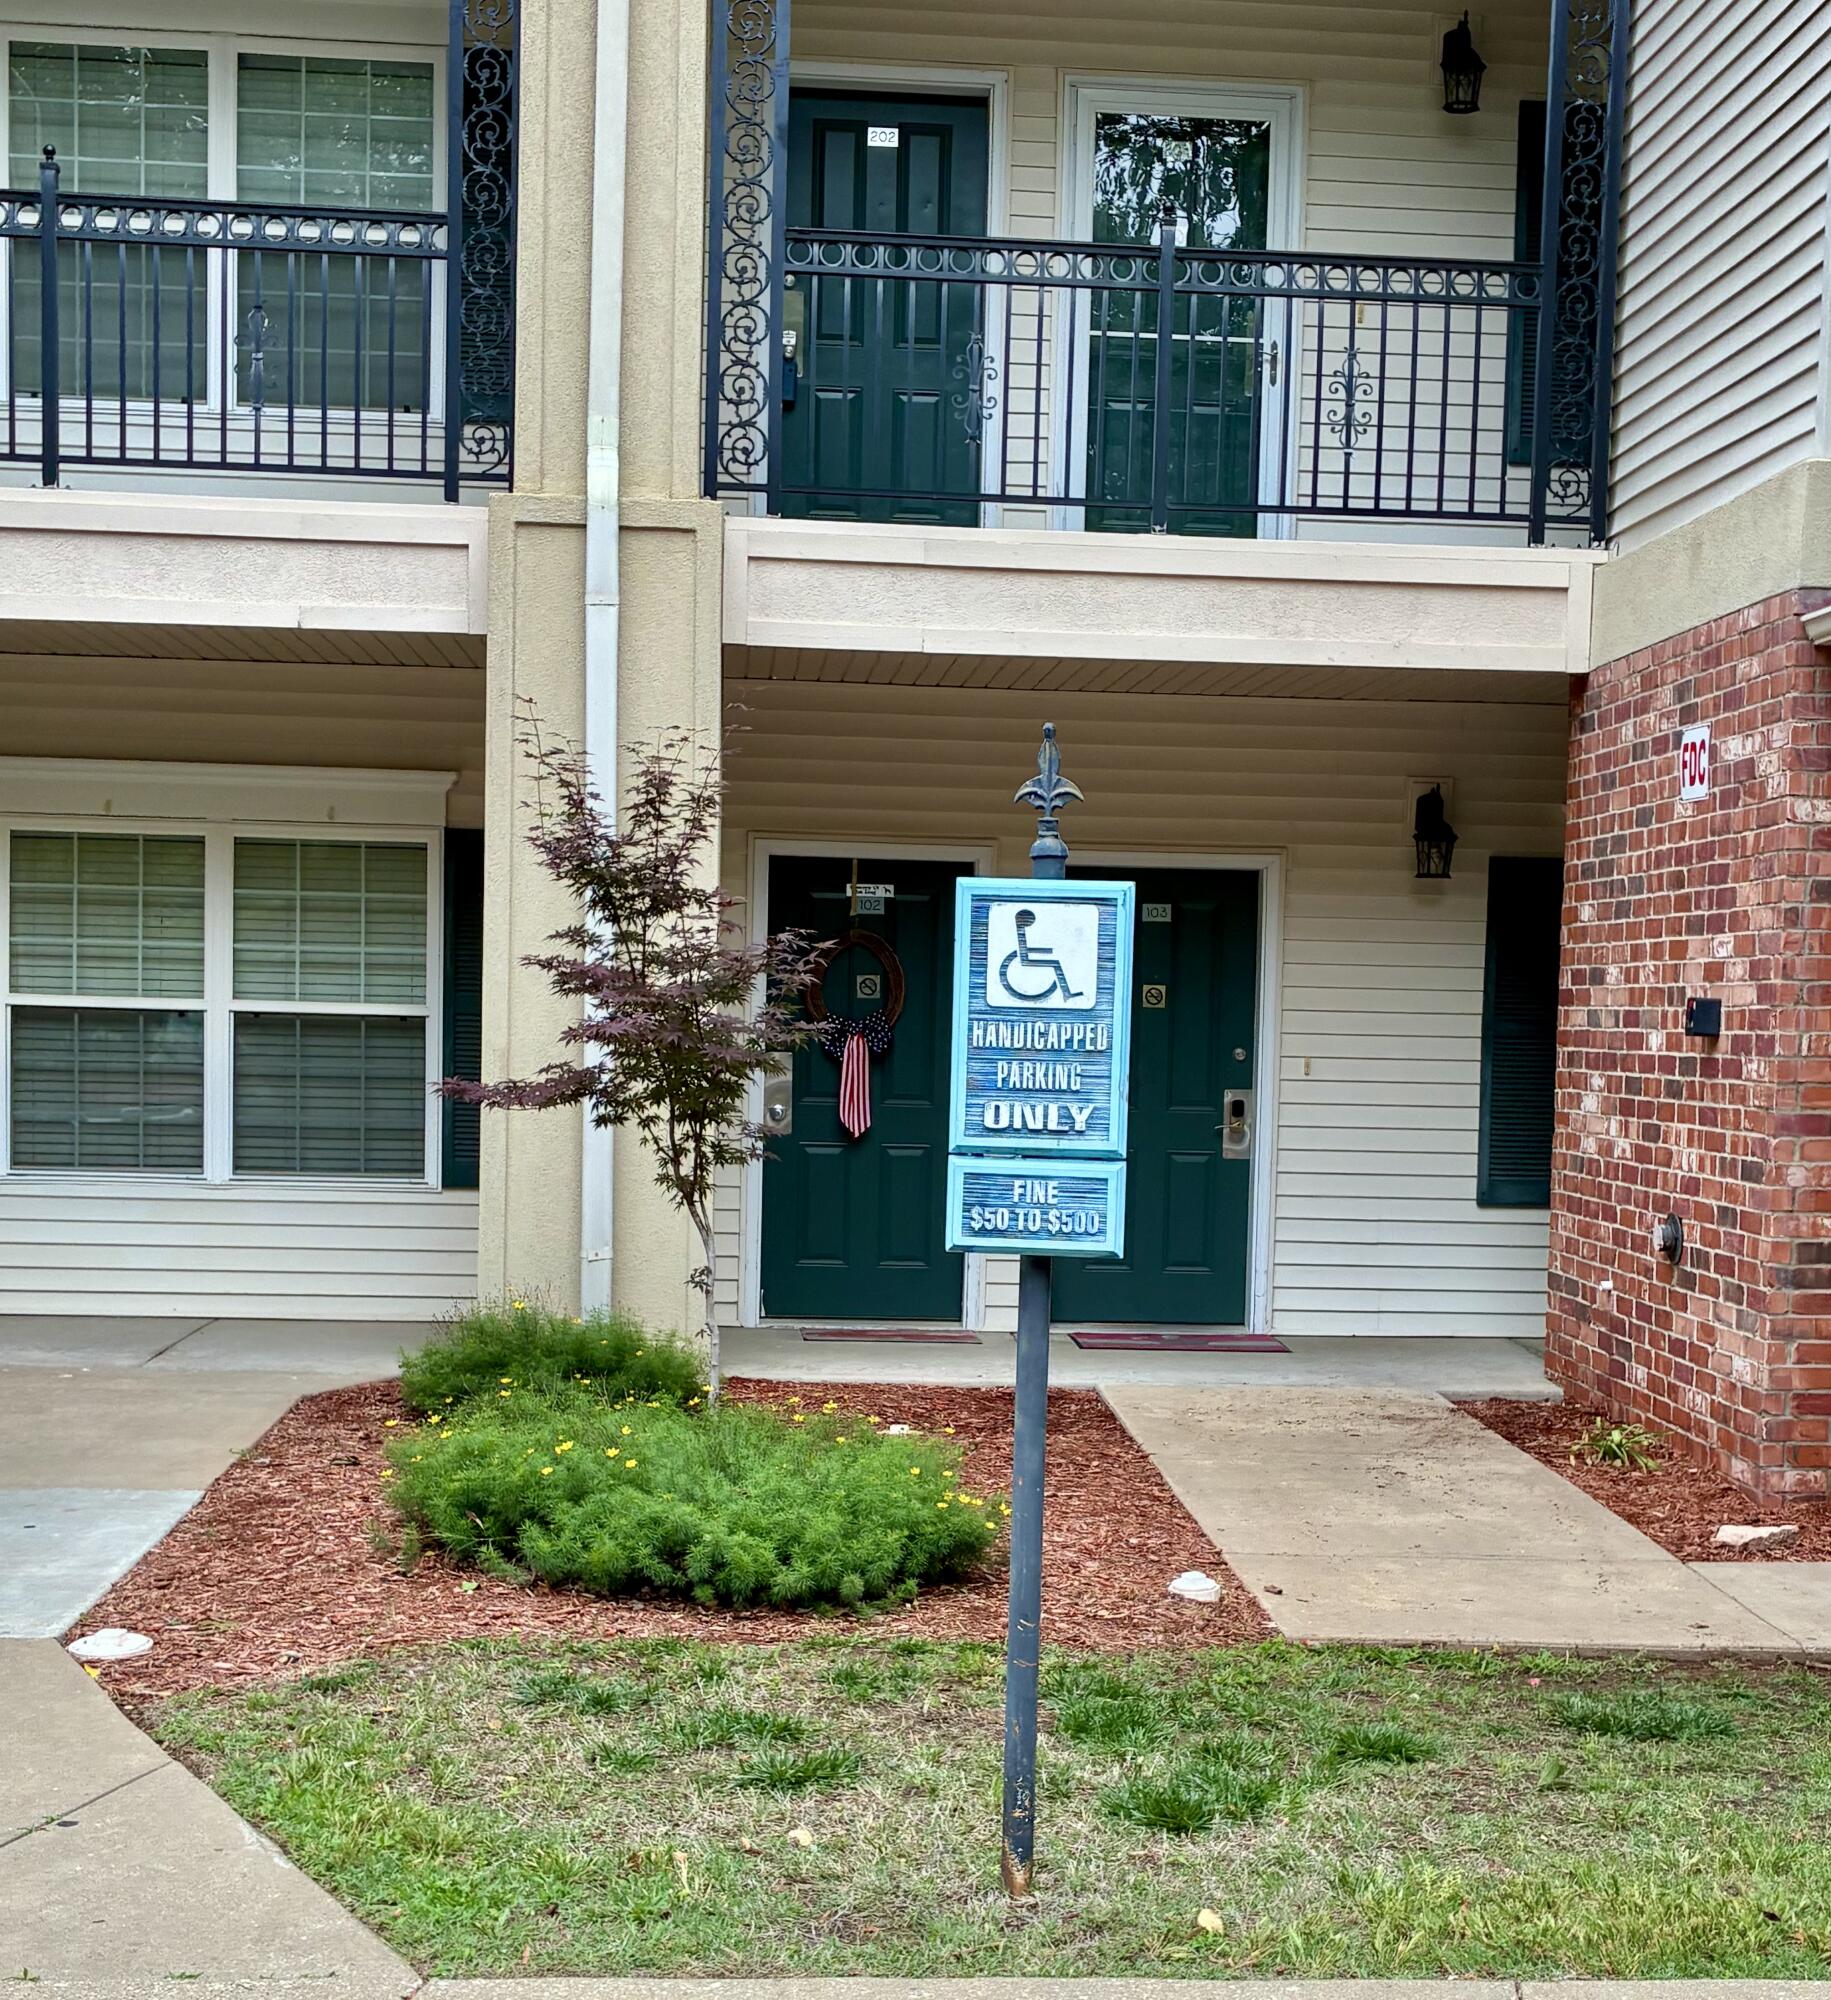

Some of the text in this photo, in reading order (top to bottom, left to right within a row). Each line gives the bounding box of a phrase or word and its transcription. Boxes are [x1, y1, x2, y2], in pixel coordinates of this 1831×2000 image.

[870, 130, 896, 143] 202
[1682, 739, 1706, 787] FDC
[860, 899, 881, 911] 102
[1146, 906, 1168, 918] 103
[972, 1021, 1108, 1050] HANDICAPPED
[997, 1061, 1082, 1090] PARKING
[983, 1101, 1094, 1131] ONLY
[1013, 1180, 1059, 1204] FINE
[970, 1206, 1100, 1236] $50 TO $500
